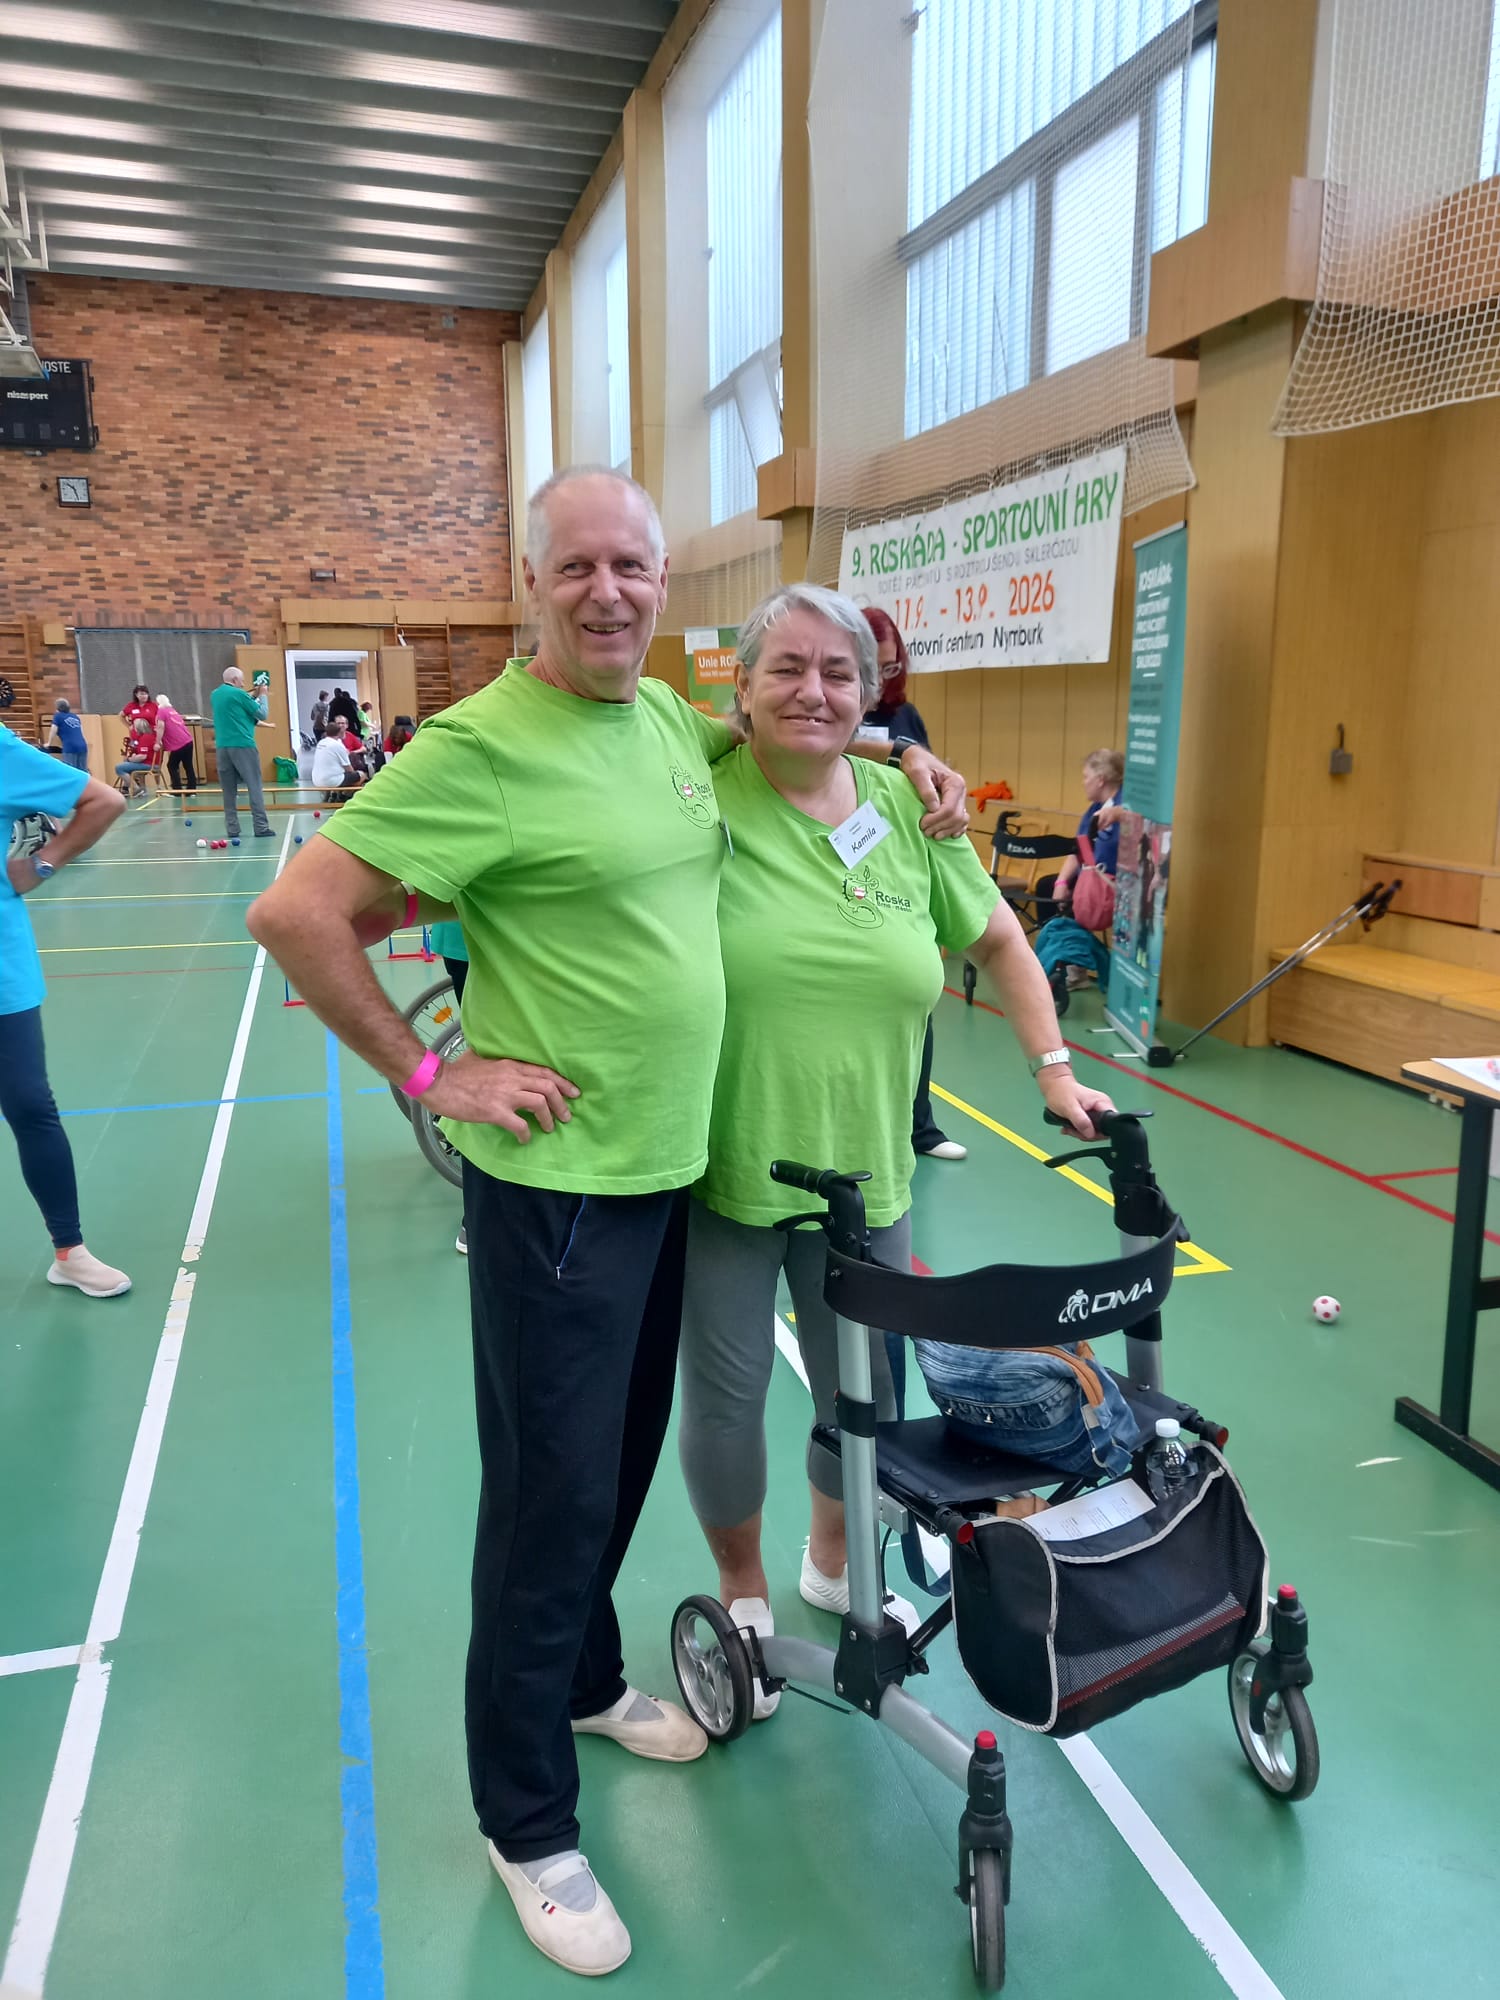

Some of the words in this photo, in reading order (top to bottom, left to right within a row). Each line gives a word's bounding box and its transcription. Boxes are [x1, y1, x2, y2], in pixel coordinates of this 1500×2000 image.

[852, 546, 865, 577] 9.
[1073, 471, 1118, 528] HRY
[1008, 569, 1055, 617] 2026
[906, 633, 943, 656] rtovní
[851, 826, 876, 854] Kamila
[876, 891, 911, 908] Roska
[1091, 1277, 1153, 1314] DMA
